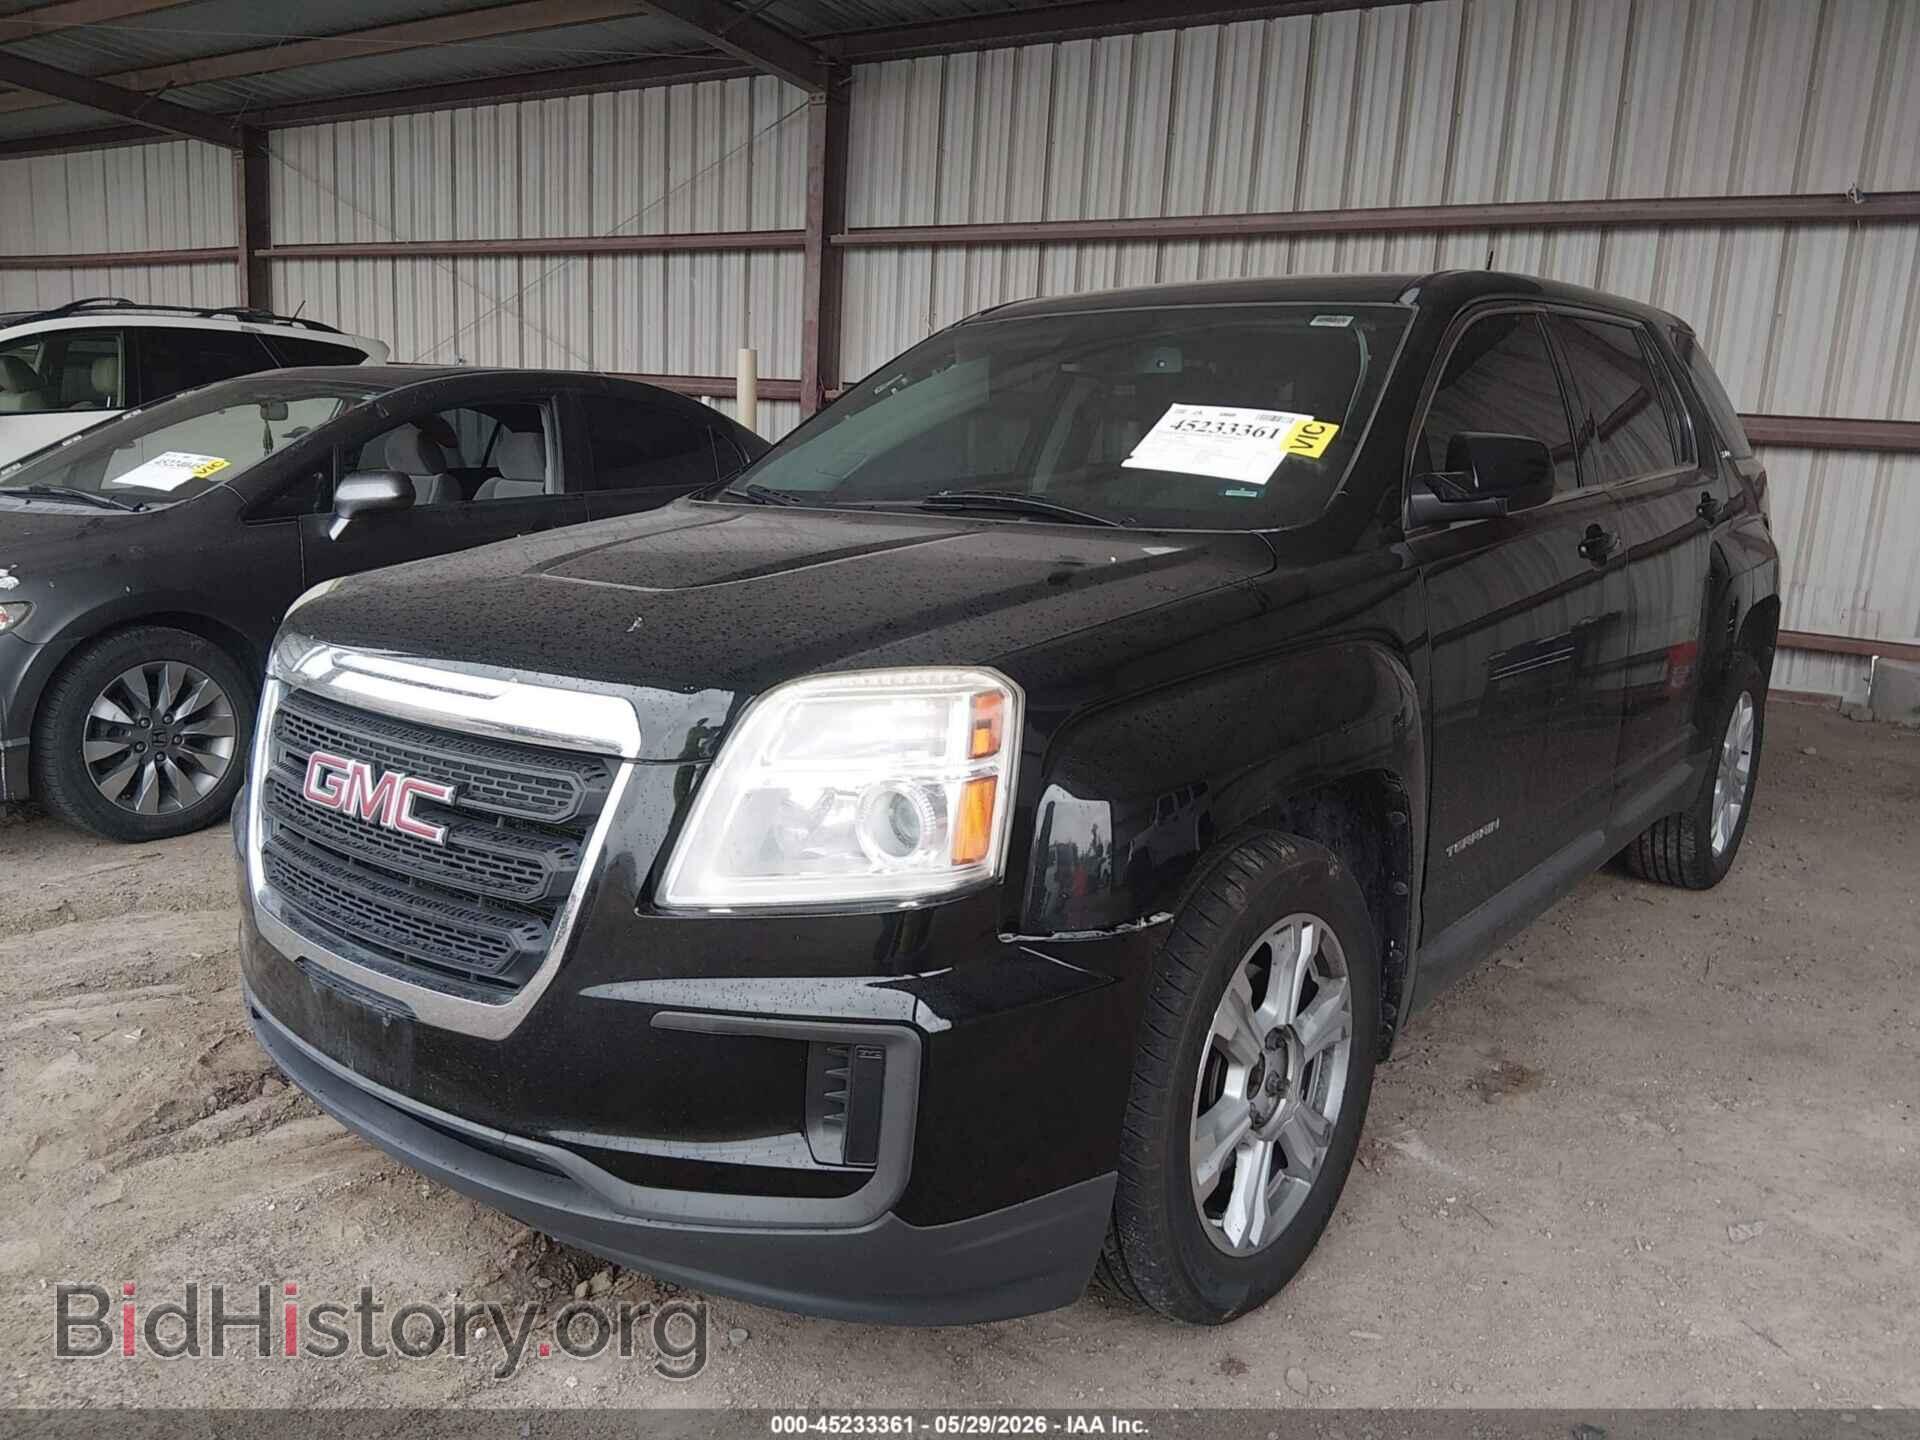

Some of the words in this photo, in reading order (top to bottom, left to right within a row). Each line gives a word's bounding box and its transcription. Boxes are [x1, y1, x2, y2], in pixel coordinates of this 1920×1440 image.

[1169, 419, 1281, 440] 45233361
[1289, 423, 1326, 450] VIC
[194, 460, 224, 474] VIC
[303, 750, 454, 845] GMC
